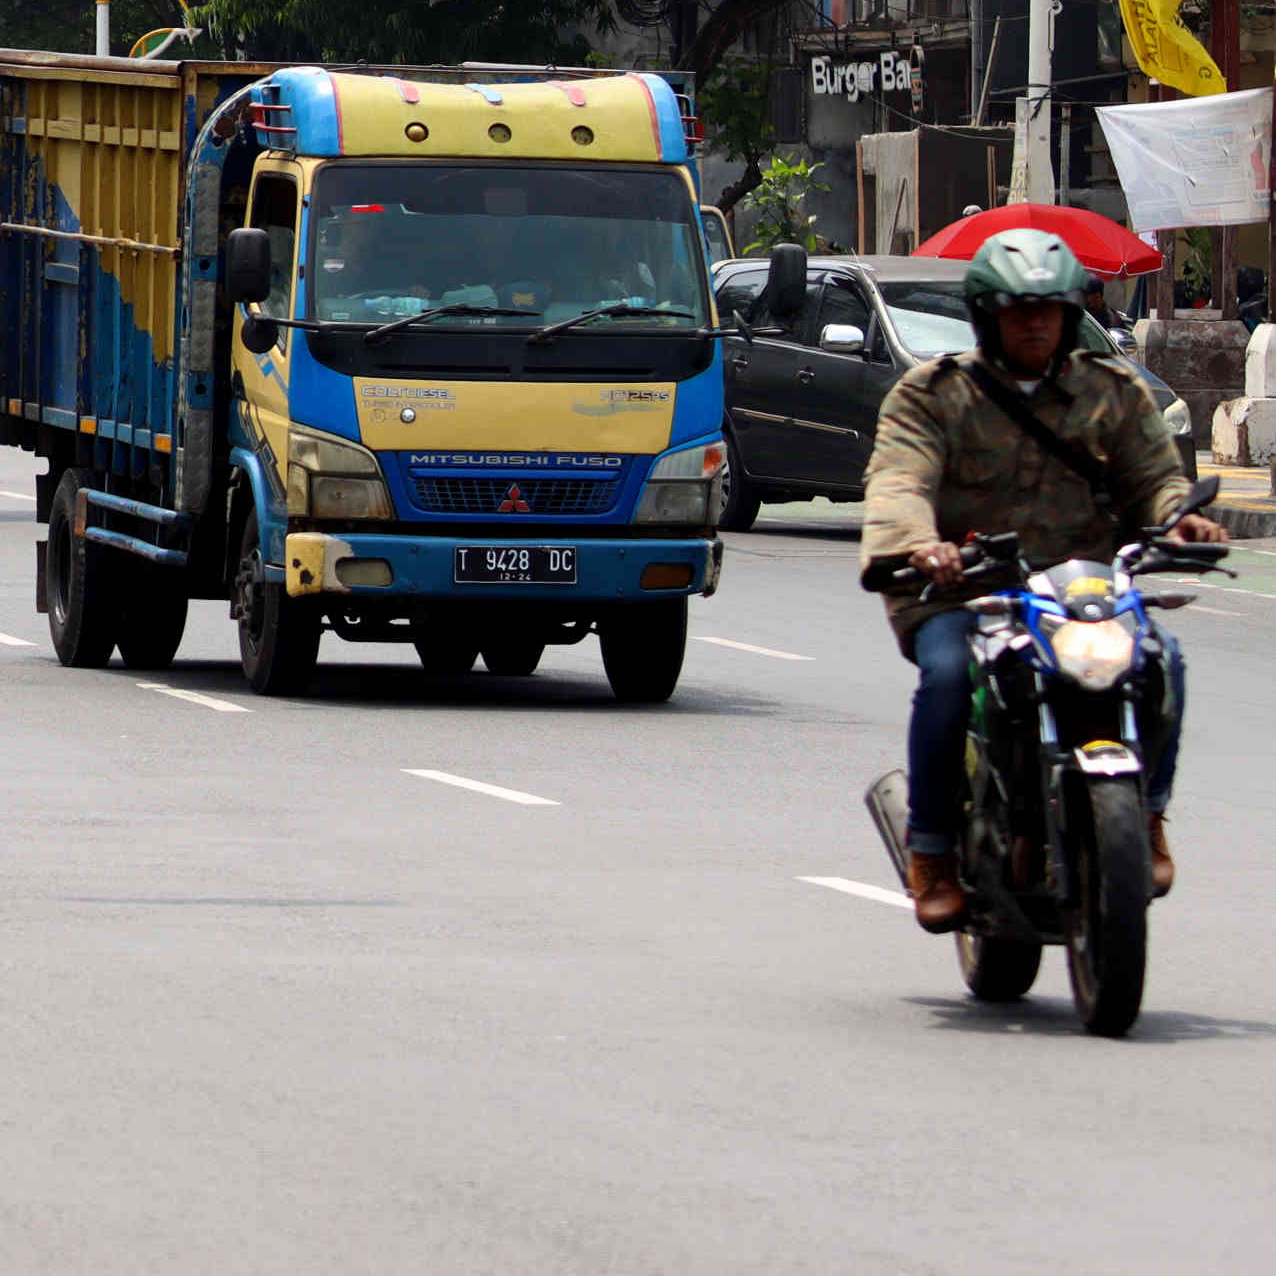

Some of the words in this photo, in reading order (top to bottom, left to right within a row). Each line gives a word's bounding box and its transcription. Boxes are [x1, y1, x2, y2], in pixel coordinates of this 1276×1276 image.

[811, 55, 878, 102] Burger
[411, 454, 548, 465] MITSUBISHI
[556, 455, 622, 466] FUSO
[458, 550, 467, 570] T
[486, 550, 530, 570] 9428
[550, 550, 572, 570] DC
